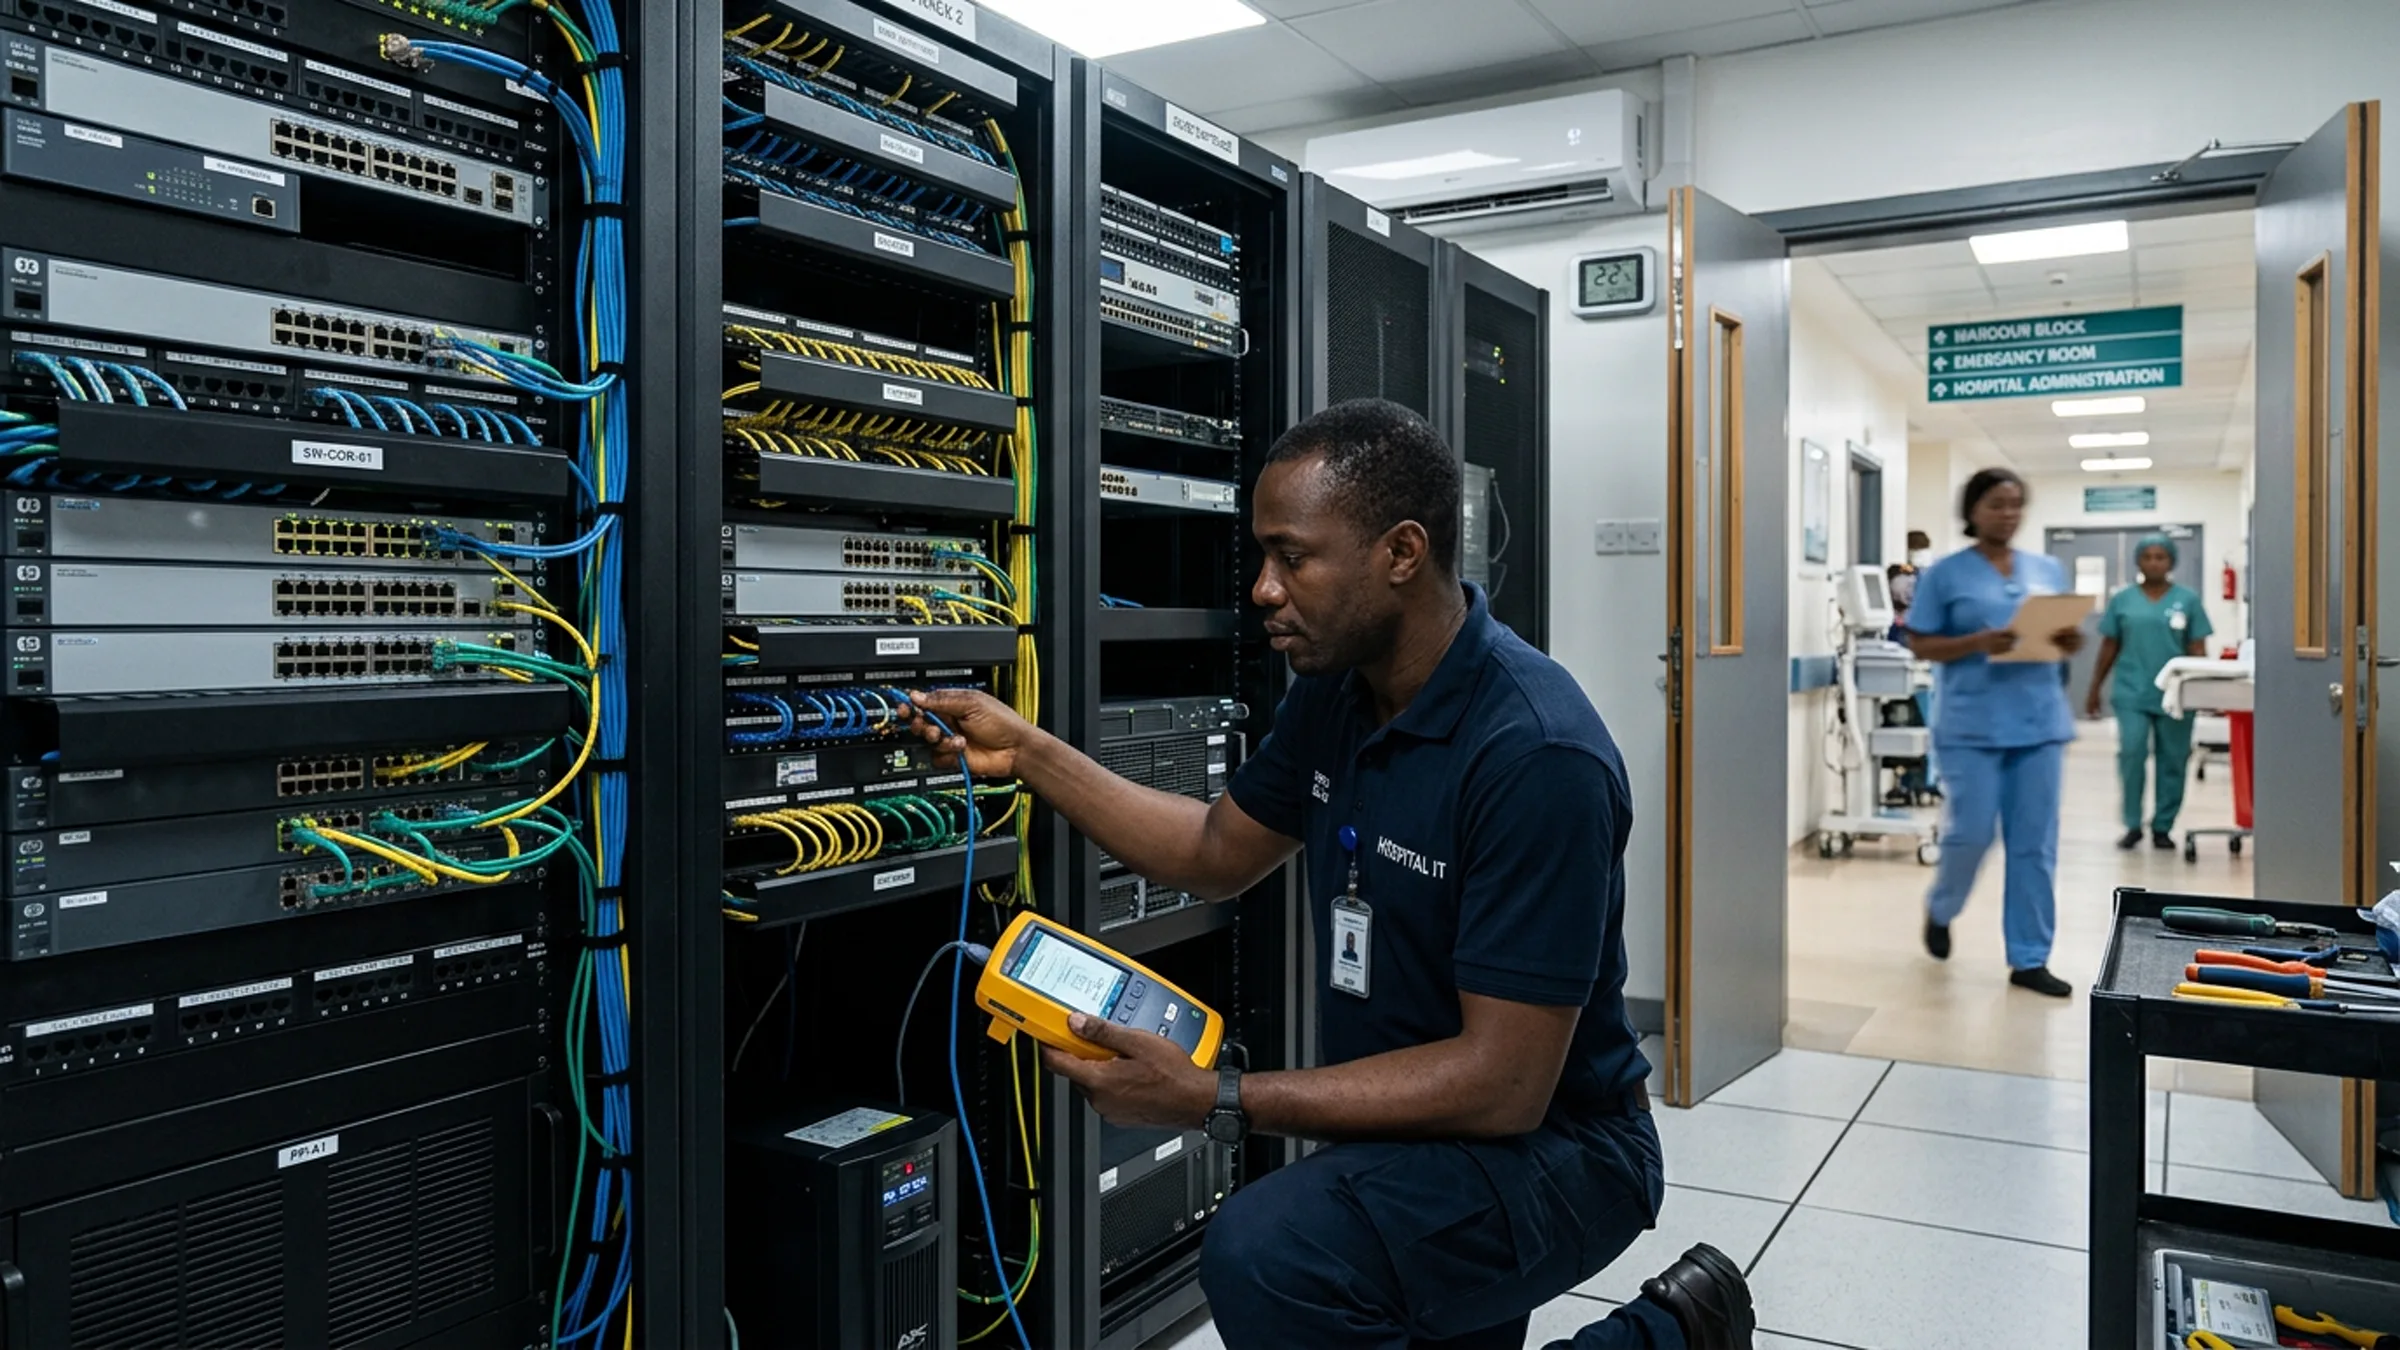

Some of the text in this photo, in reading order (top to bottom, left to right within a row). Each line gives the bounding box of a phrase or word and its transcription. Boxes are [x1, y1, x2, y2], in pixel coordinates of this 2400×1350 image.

[956, 9, 964, 25] 2
[2034, 319, 2086, 337] BLOCK
[2047, 345, 2096, 362] ROOM
[1432, 860, 1447, 879] IT
